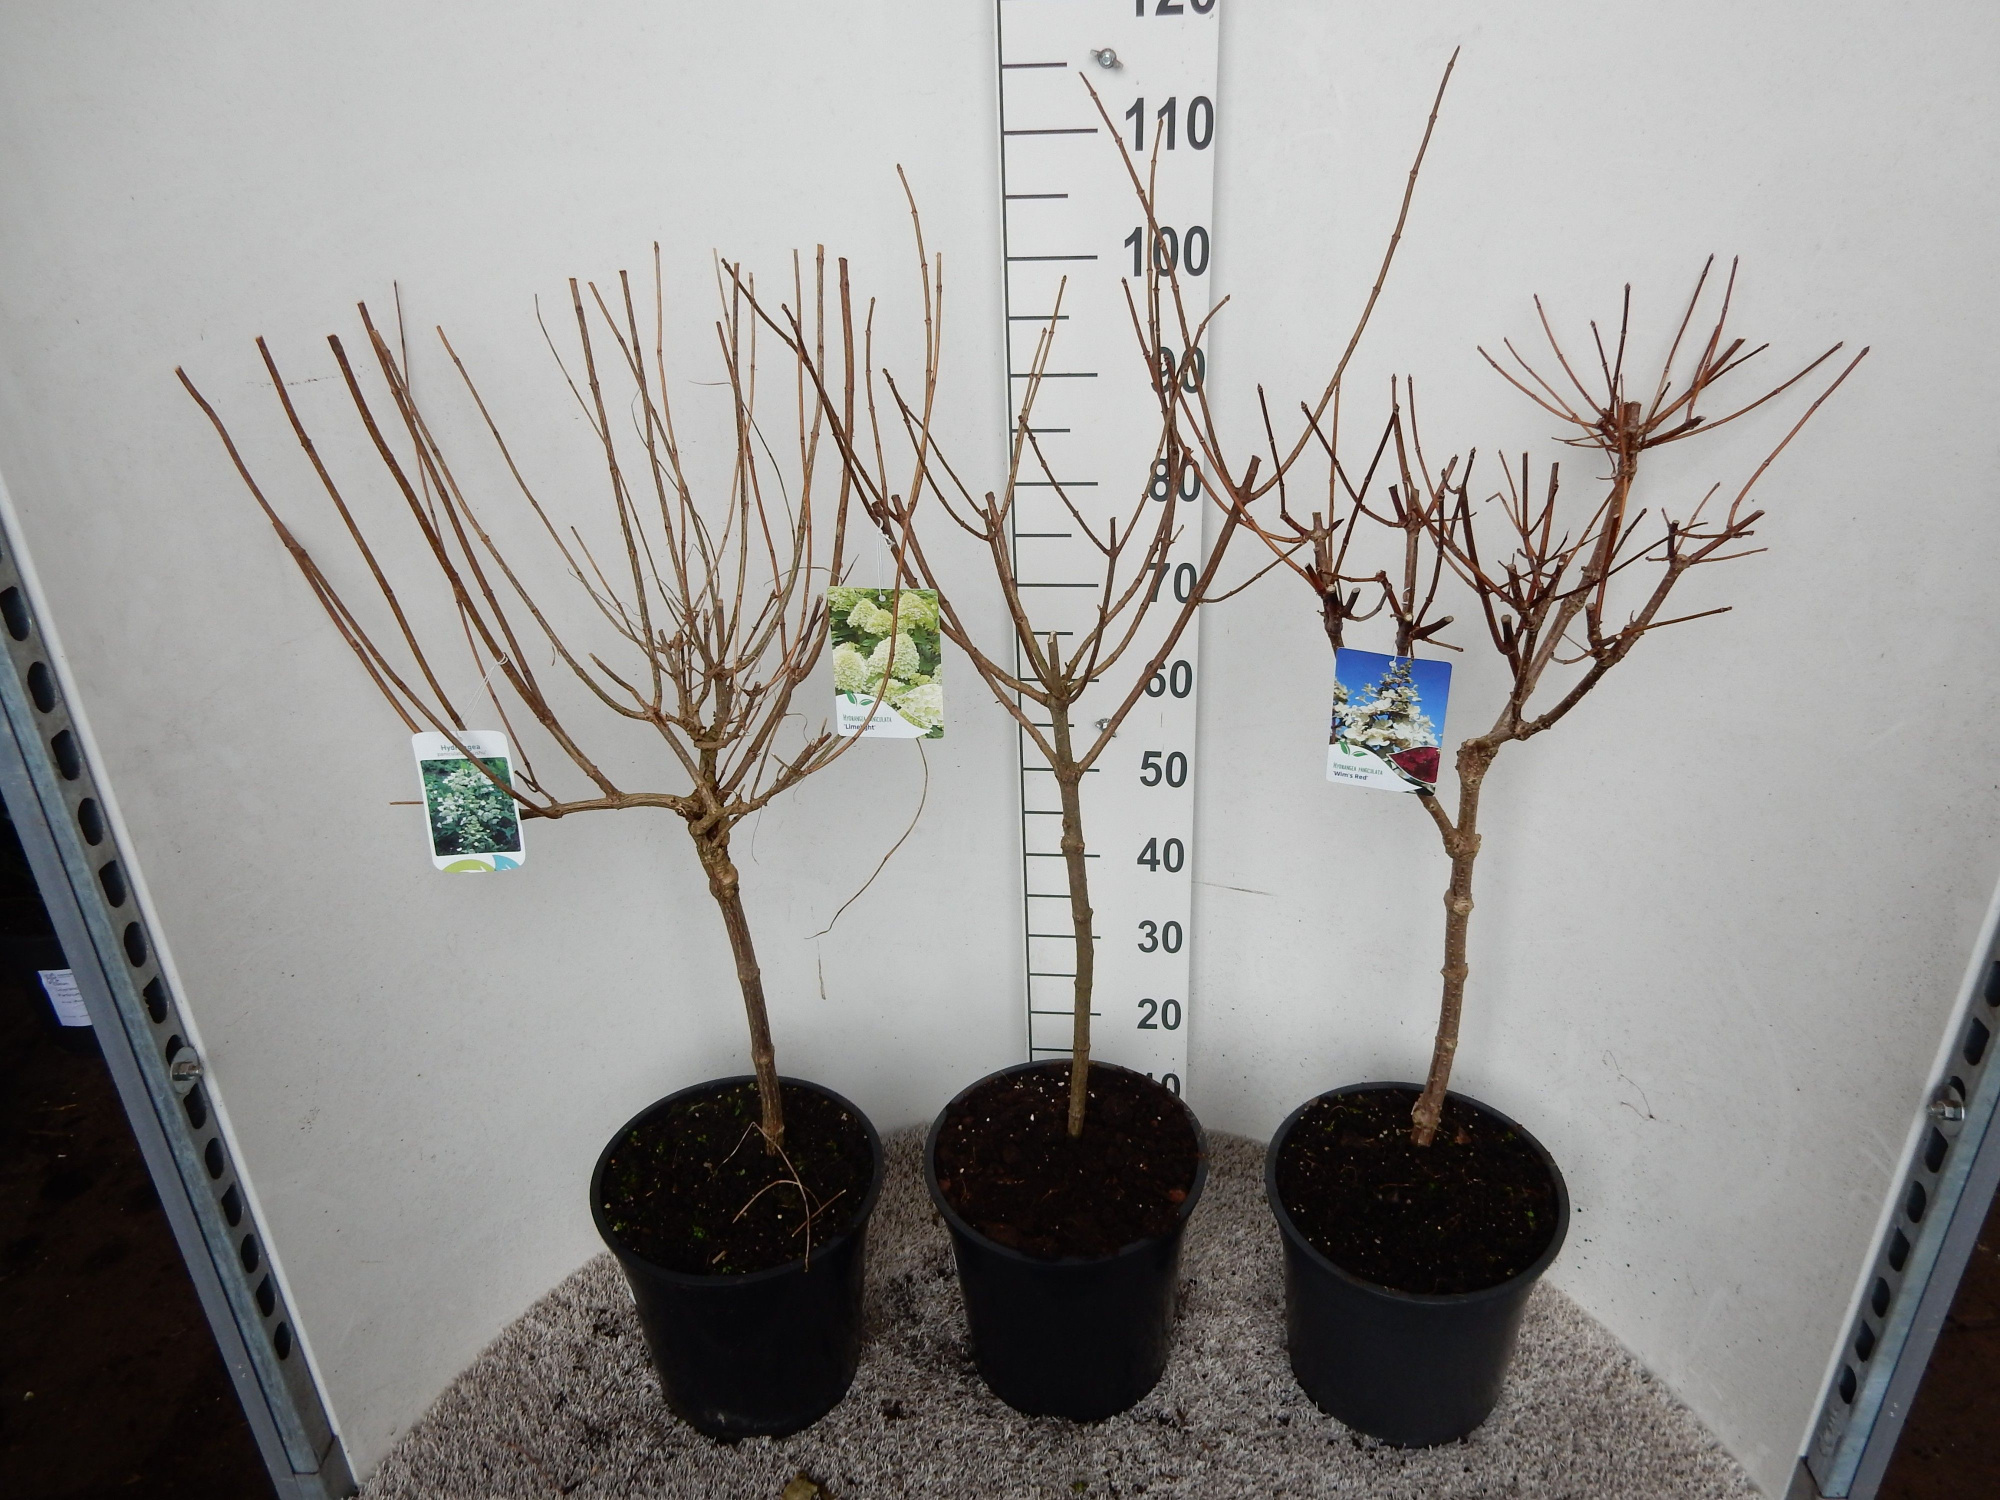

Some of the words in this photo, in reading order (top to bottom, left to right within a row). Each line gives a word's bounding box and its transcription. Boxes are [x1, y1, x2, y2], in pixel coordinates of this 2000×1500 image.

[1125, 96, 1214, 152] 110
[1124, 225, 1210, 278] 100
[1150, 346, 1206, 394] 90
[1148, 458, 1201, 503] 80
[1147, 562, 1199, 604] 70
[1144, 659, 1193, 699] 60
[1139, 750, 1188, 788] 50
[1137, 837, 1185, 873] 40
[1137, 920, 1183, 954] 30
[1137, 998, 1182, 1030] 20
[1147, 1072, 1181, 1099] 0
